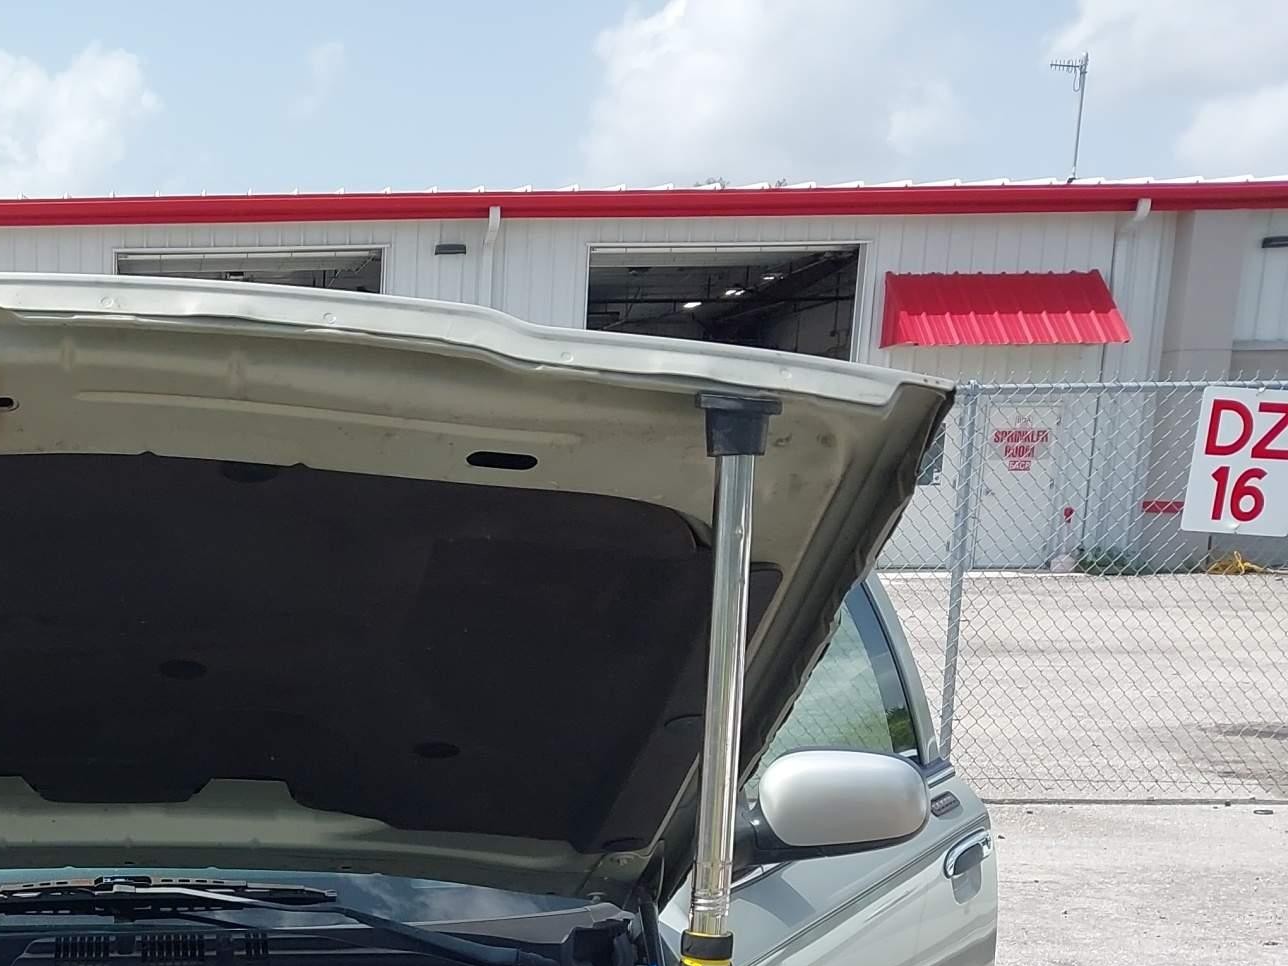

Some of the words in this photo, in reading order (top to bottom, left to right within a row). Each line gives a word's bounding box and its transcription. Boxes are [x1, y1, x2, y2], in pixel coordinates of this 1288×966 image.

[993, 430, 1049, 443] SPRINKLER
[1205, 399, 1288, 460] DZ
[1211, 466, 1268, 522] 16
